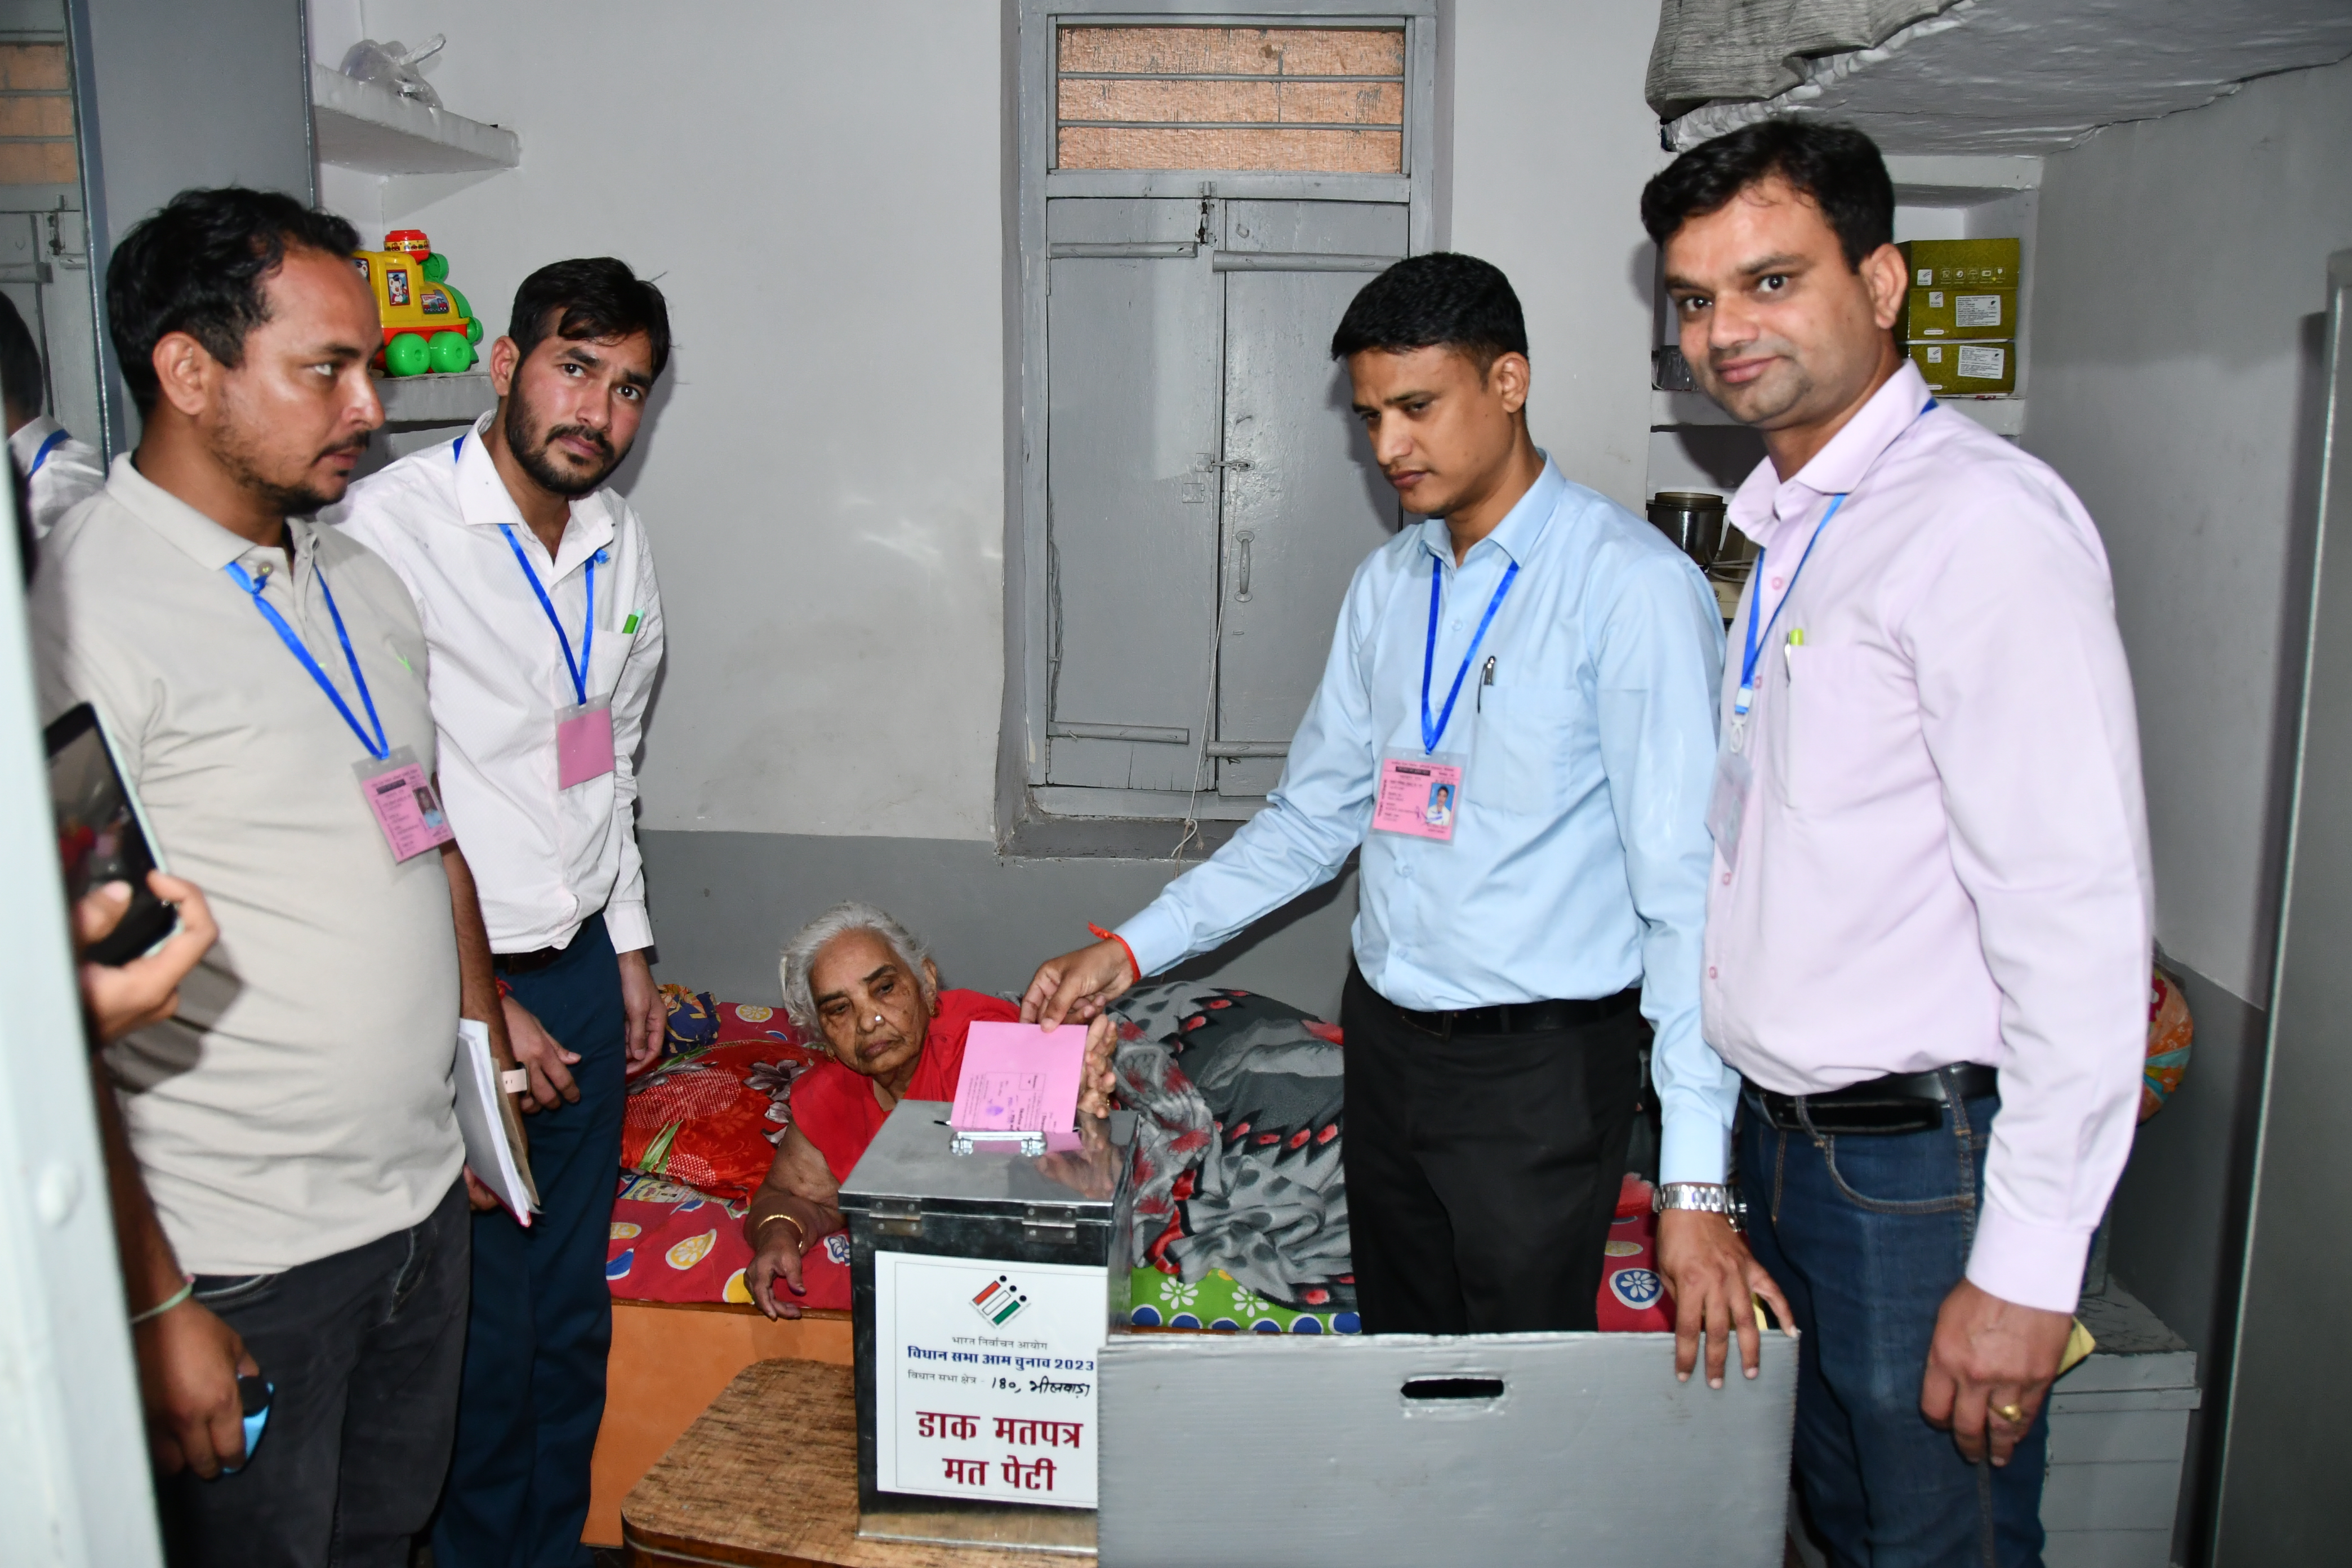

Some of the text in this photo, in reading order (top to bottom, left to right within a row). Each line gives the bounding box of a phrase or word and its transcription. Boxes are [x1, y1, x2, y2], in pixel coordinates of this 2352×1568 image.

[952, 1336, 1048, 1350] भारत निर्वाचन आयोग
[907, 1346, 1094, 1371] विधान सभा आम चुनाव 2023
[908, 1369, 935, 1380] विधान
[961, 1373, 977, 1384] क्षेत्र
[916, 1411, 1084, 1448] डाक मतपत्र
[942, 1455, 1057, 1491] मत पेटी
